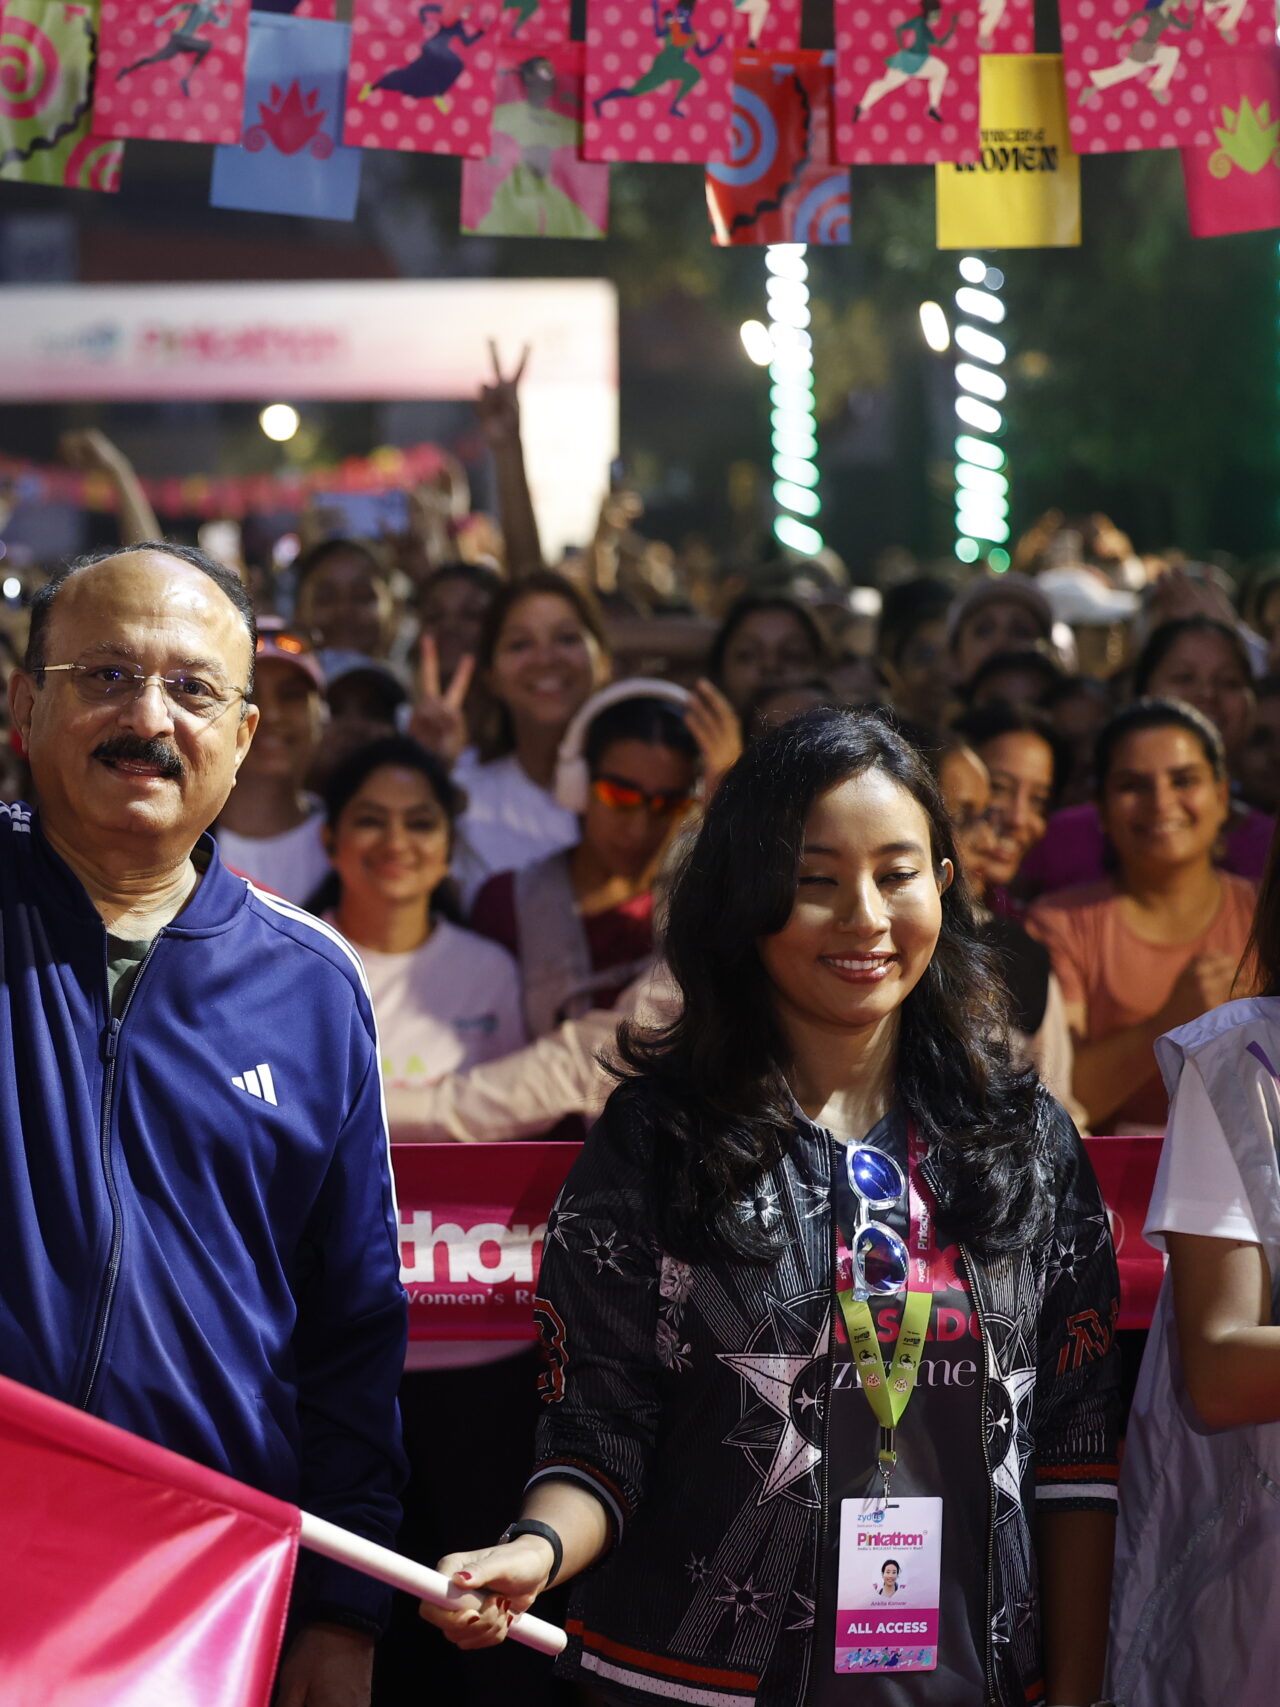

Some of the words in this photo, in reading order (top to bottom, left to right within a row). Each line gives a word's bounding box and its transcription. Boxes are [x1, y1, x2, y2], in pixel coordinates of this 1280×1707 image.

[857, 1532, 923, 1546] Pinkathon
[847, 1622, 873, 1634] ALL
[875, 1621, 928, 1634] ACCESS
